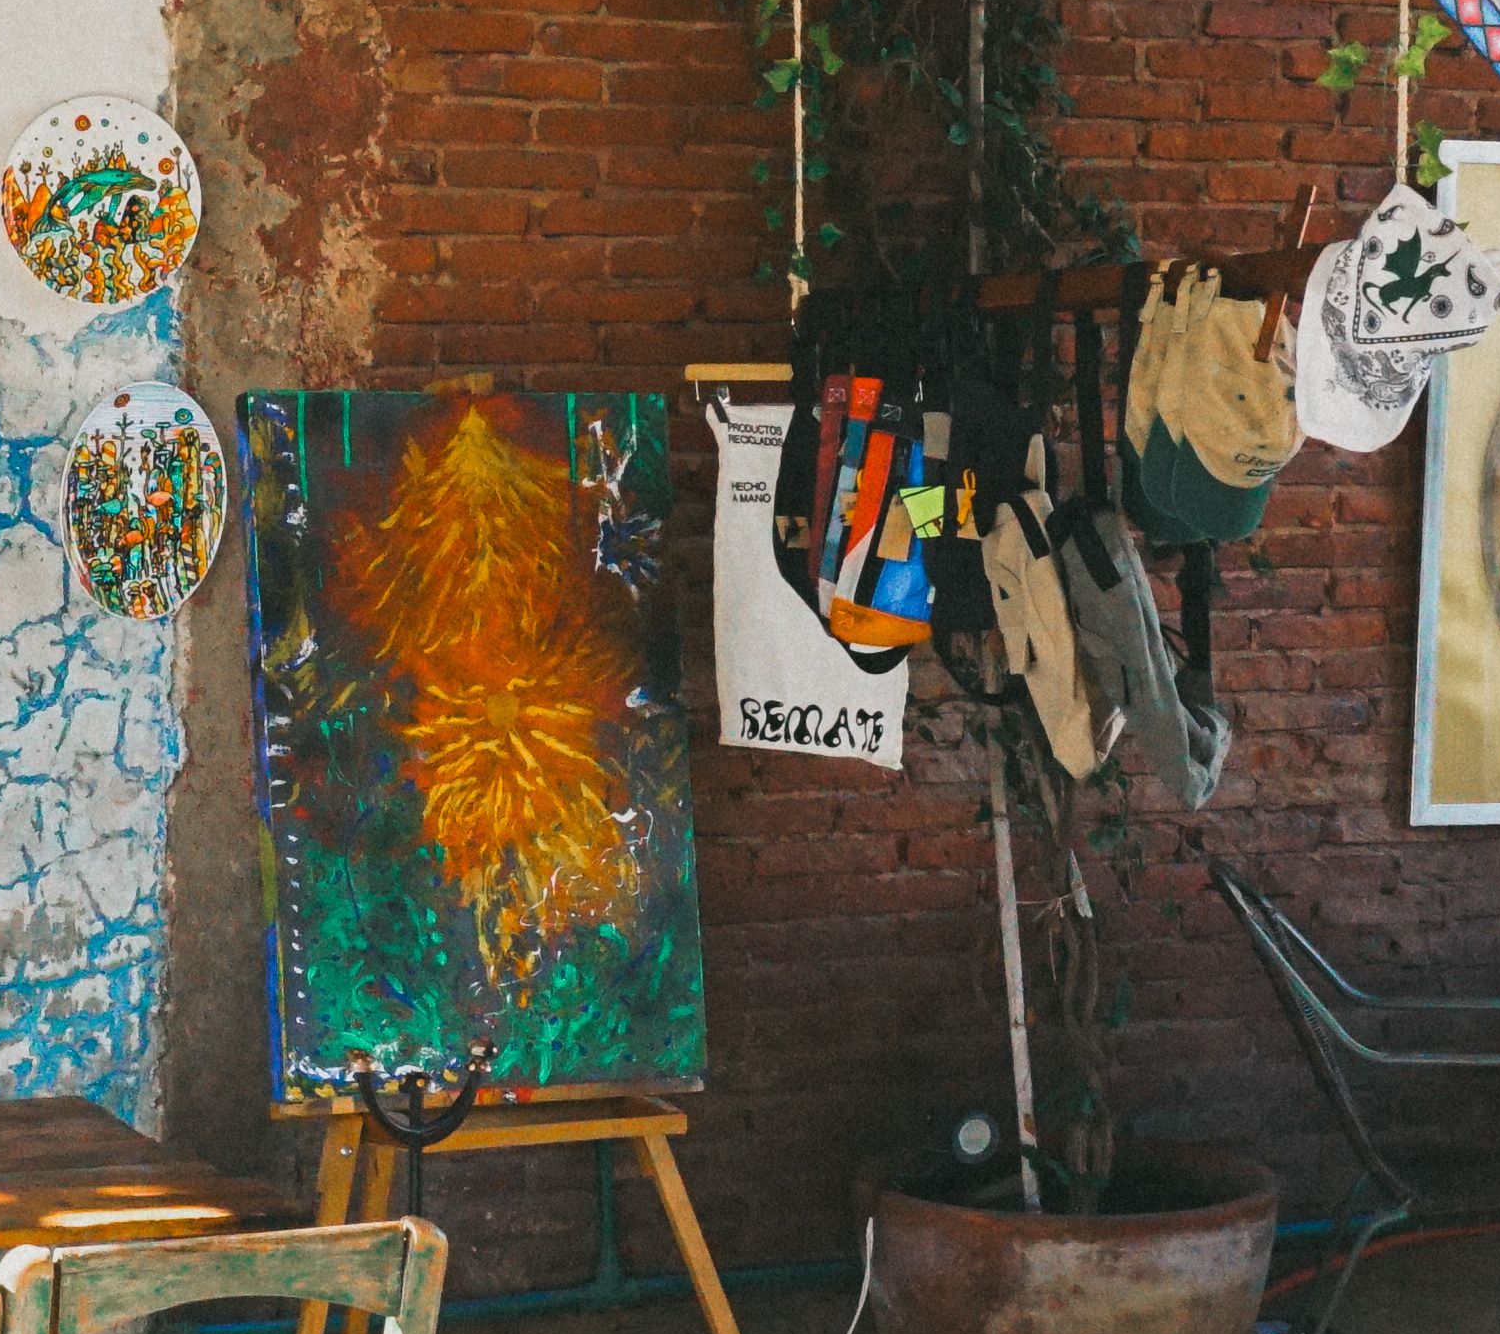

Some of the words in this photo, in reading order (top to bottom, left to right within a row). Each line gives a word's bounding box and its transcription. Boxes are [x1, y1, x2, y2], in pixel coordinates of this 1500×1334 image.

[727, 423, 782, 435] PRODUCTOS
[728, 434, 783, 446] RECICLADOS
[731, 481, 767, 492] HECHO
[740, 493, 772, 503] MANO
[740, 697, 884, 753] REMATE
